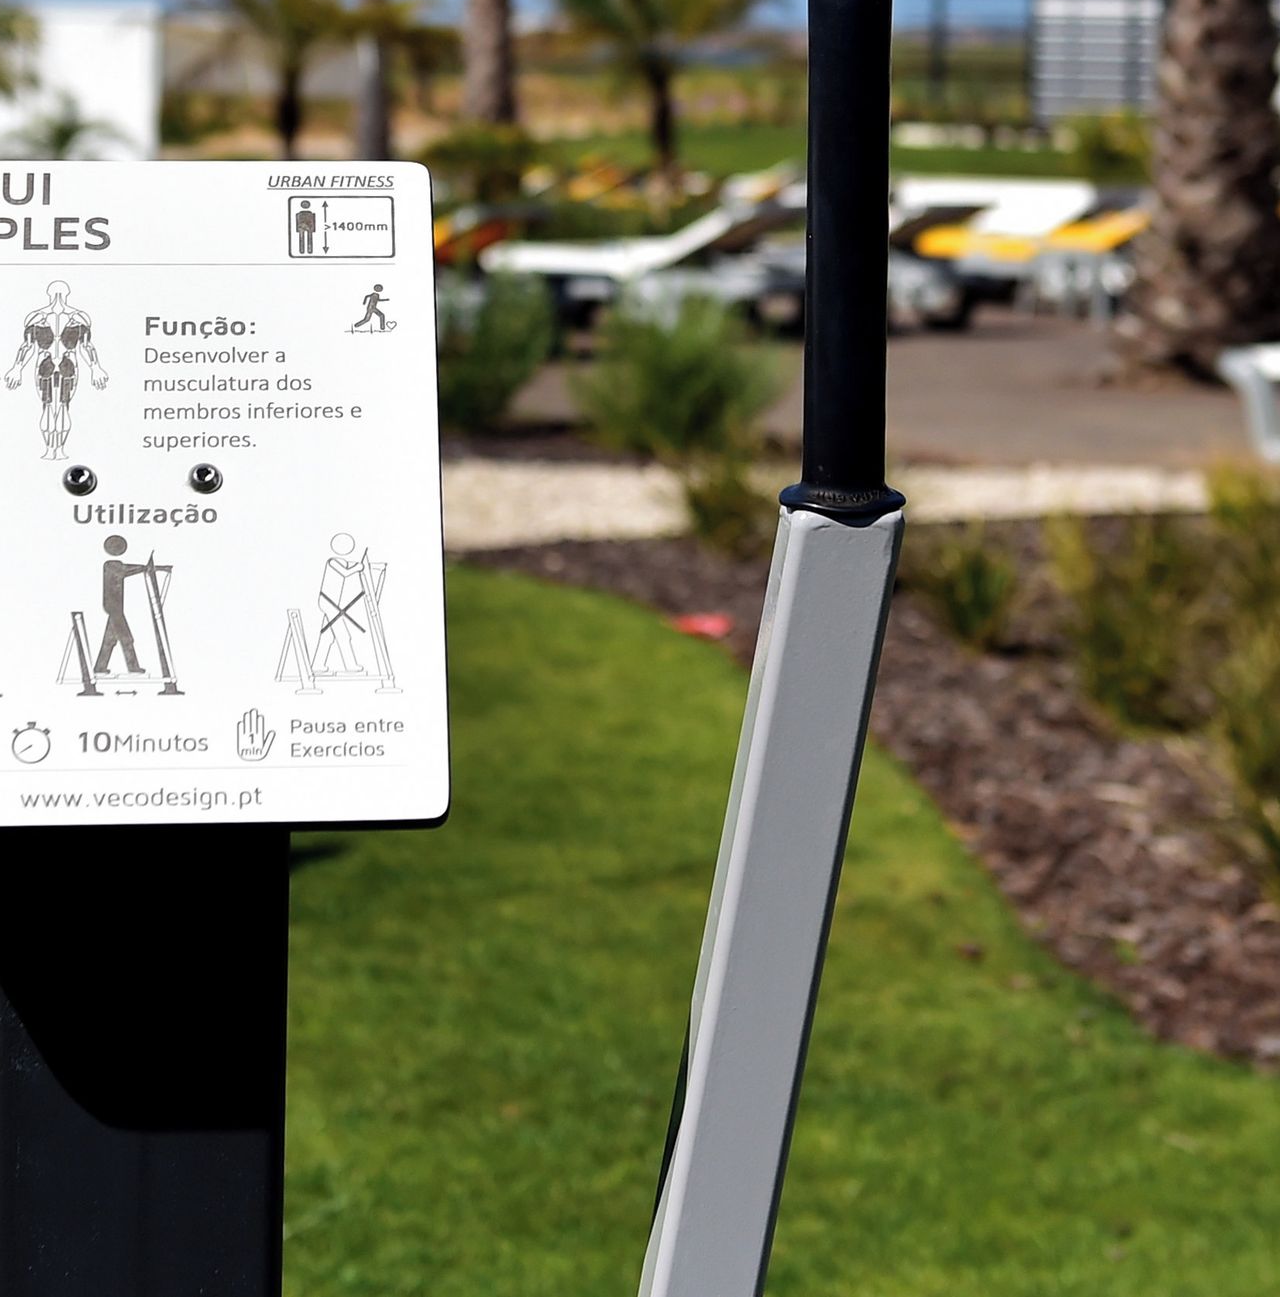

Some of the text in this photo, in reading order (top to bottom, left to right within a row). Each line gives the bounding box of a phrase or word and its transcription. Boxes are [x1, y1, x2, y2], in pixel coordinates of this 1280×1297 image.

[267, 175, 395, 188] URBAN FITNESS
[144, 316, 256, 339] Função:
[144, 346, 287, 364] Desenvolver a
[143, 374, 312, 392] musculatura dos
[143, 402, 363, 420] membros inferiores e
[142, 432, 257, 452] superiores.
[73, 503, 218, 527] Utilização
[290, 718, 405, 735] Pausa entre
[290, 741, 386, 758] Exercícios
[20, 787, 263, 811] www.vecodesign.pt
